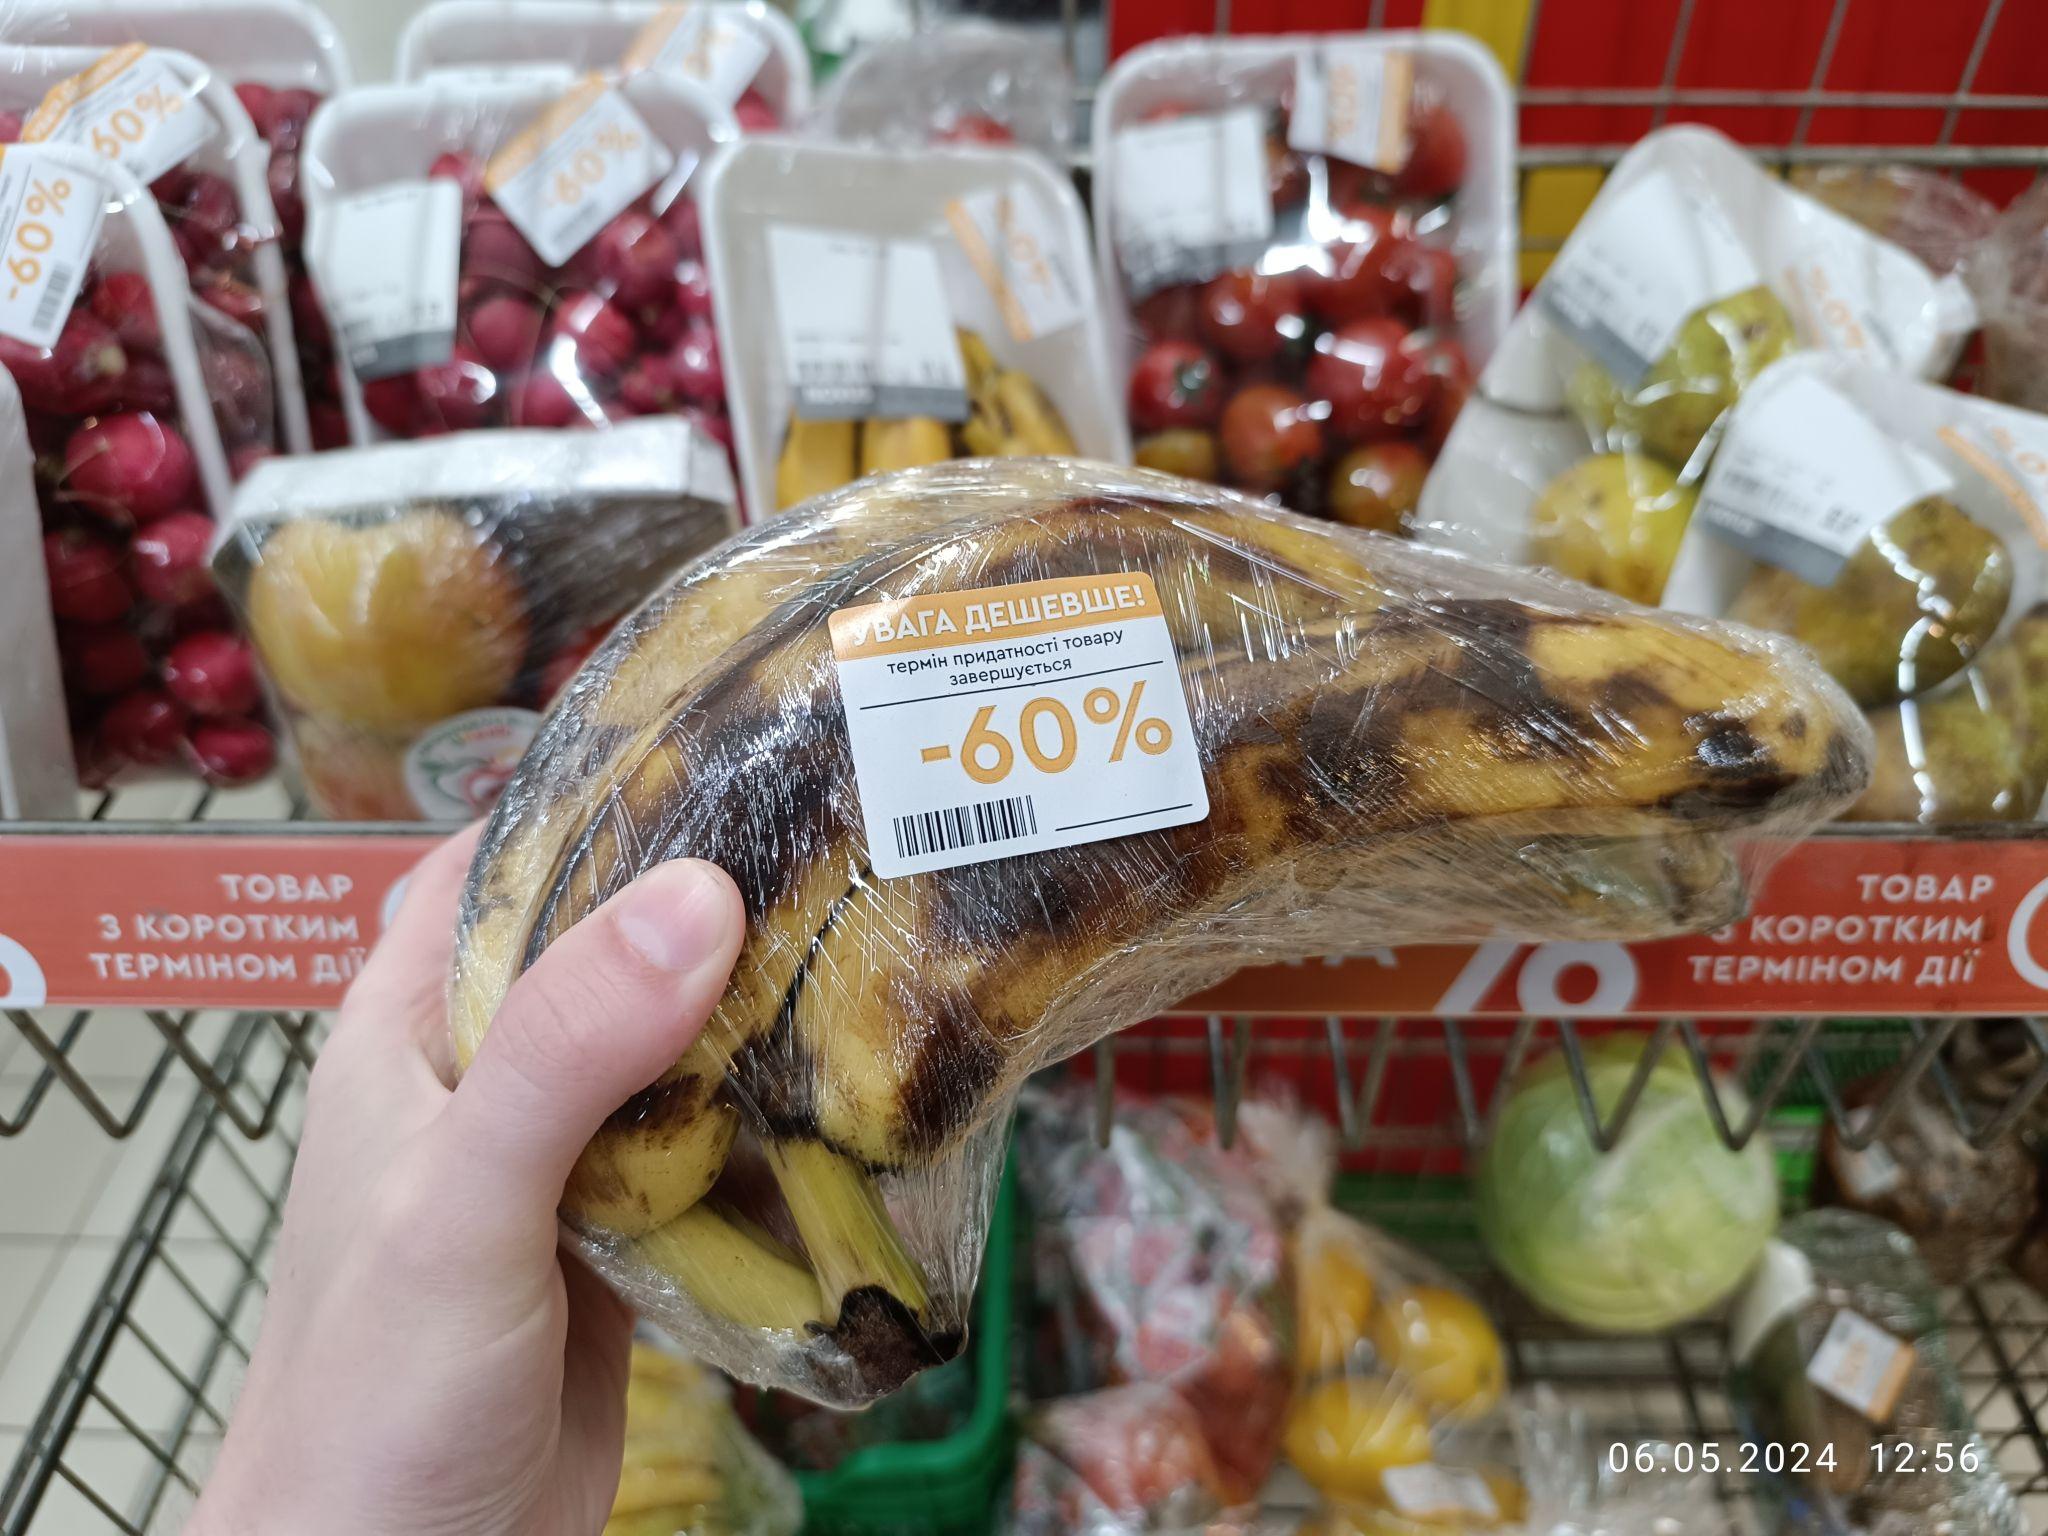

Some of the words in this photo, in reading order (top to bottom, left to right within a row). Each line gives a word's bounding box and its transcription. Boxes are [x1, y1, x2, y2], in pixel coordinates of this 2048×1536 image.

[7, 178, 72, 300] -60%
[852, 607, 957, 646] УВАГА
[965, 584, 1146, 635] ДЕШЕВШЕ!
[887, 653, 947, 675] термін
[953, 637, 1058, 670] придатності
[1062, 629, 1124, 651] товару
[950, 657, 1072, 687] завершується
[920, 680, 1173, 785] -60%
[218, 873, 353, 901] ТОВАР
[1856, 874, 1993, 901] ТОВАР
[99, 913, 122, 941] З
[133, 914, 359, 942] КОРОТКИМ
[1750, 915, 1983, 943] КОРОТКИМ
[88, 953, 297, 980] ТЕРМІНОМ
[1687, 955, 1905, 984] ТЕРМІНОМ
[1914, 947, 1981, 986] ДІЇ
